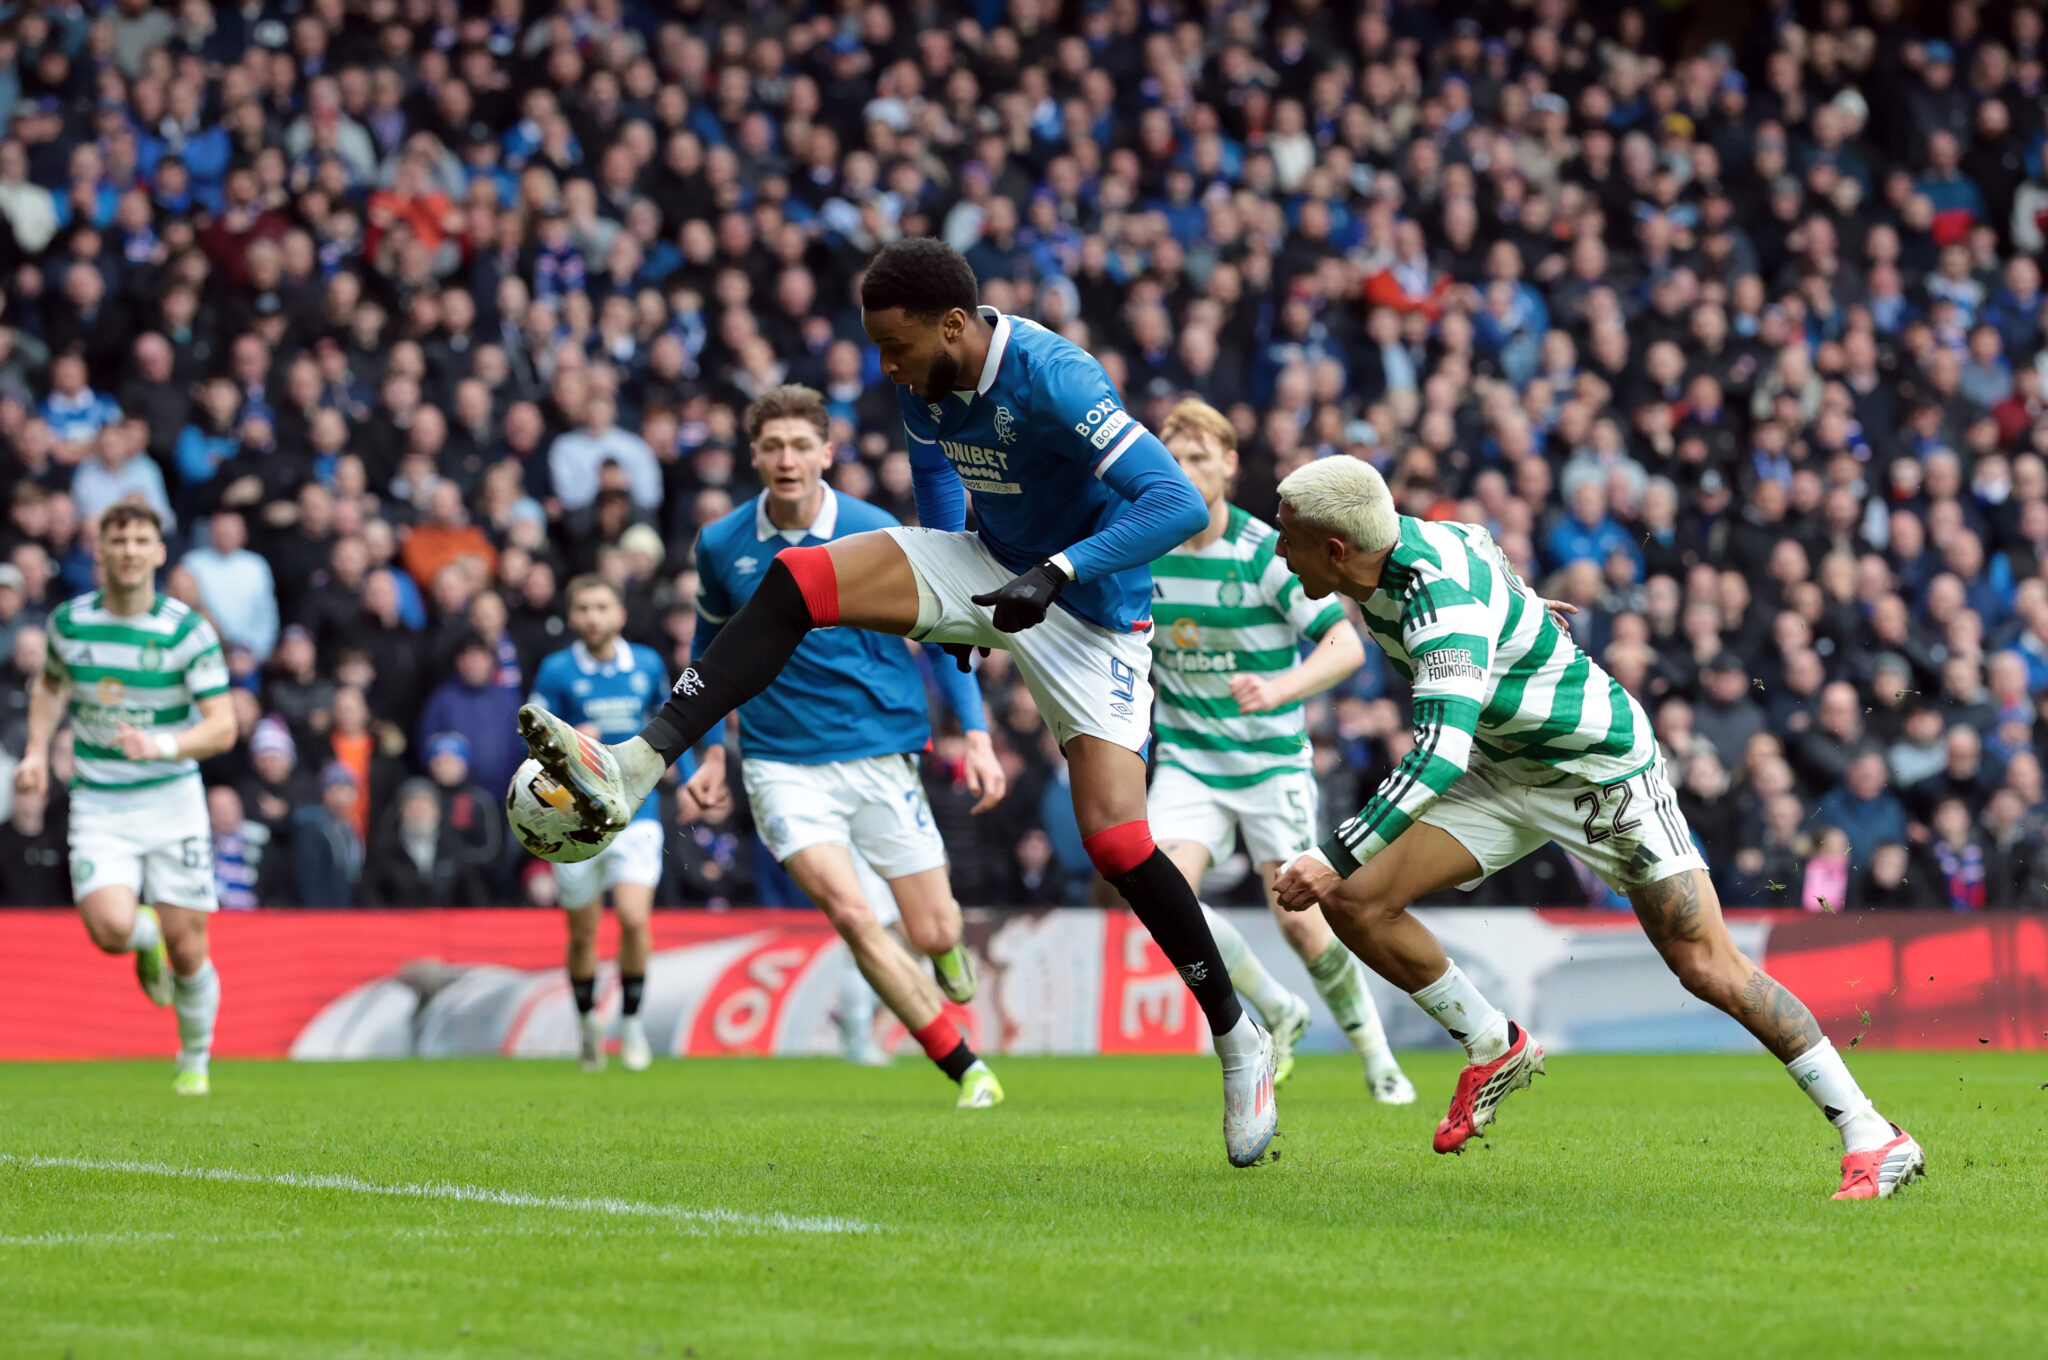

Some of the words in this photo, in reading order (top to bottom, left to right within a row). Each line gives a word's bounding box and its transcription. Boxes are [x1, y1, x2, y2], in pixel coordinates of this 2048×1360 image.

[939, 440, 1008, 471] UNIBET
[1425, 649, 1457, 667] CELTIC
[1459, 649, 1471, 664] FC
[1429, 664, 1483, 682] FOUNDATION
[1110, 657, 1135, 702] 9
[1286, 789, 1308, 824] 5
[1573, 779, 1643, 845] 22
